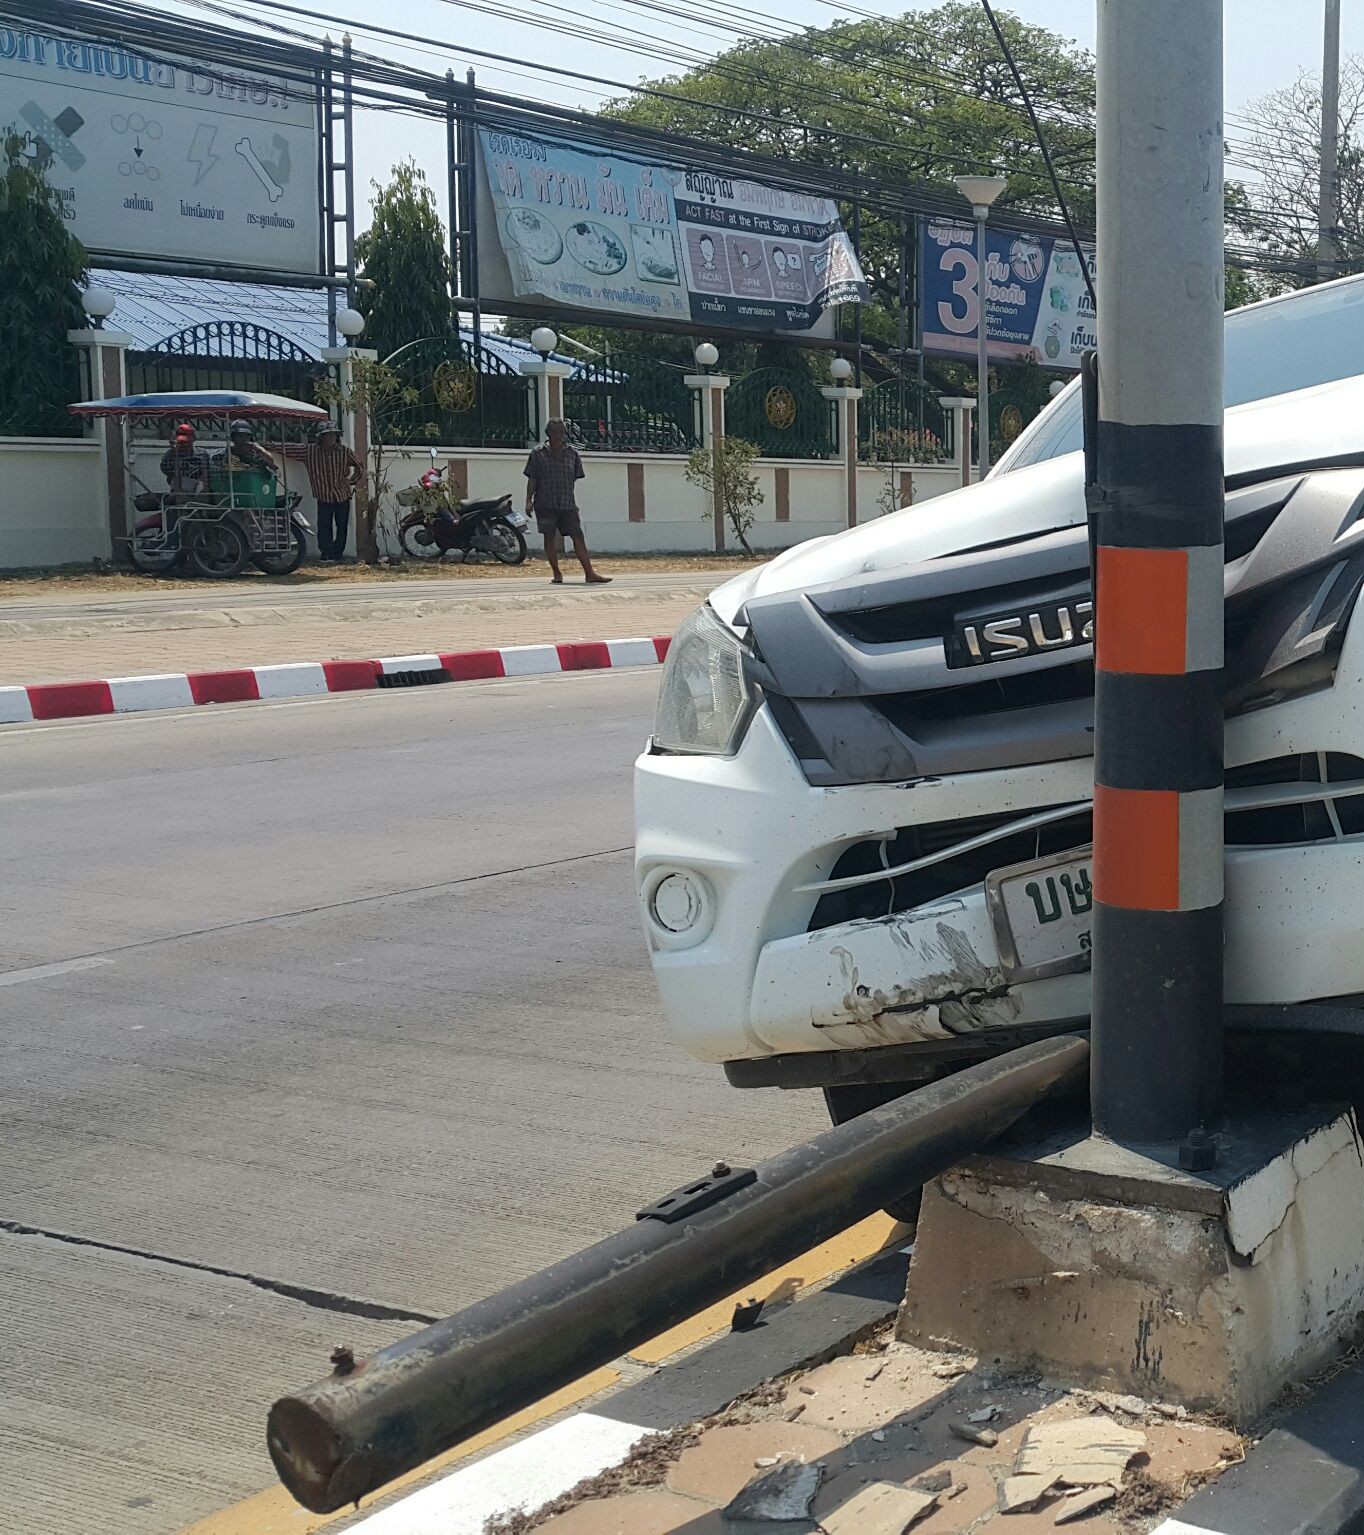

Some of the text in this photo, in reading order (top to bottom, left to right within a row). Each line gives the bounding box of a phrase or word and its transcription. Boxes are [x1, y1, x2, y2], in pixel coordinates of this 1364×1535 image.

[123, 192, 154, 212] ลดไขมัน
[596, 163, 629, 217] มัน
[246, 211, 296, 229] กระดูกแข็งแรง
[685, 205, 835, 238] ACT FAST at the First Sign of STROKE
[937, 247, 980, 334] 3
